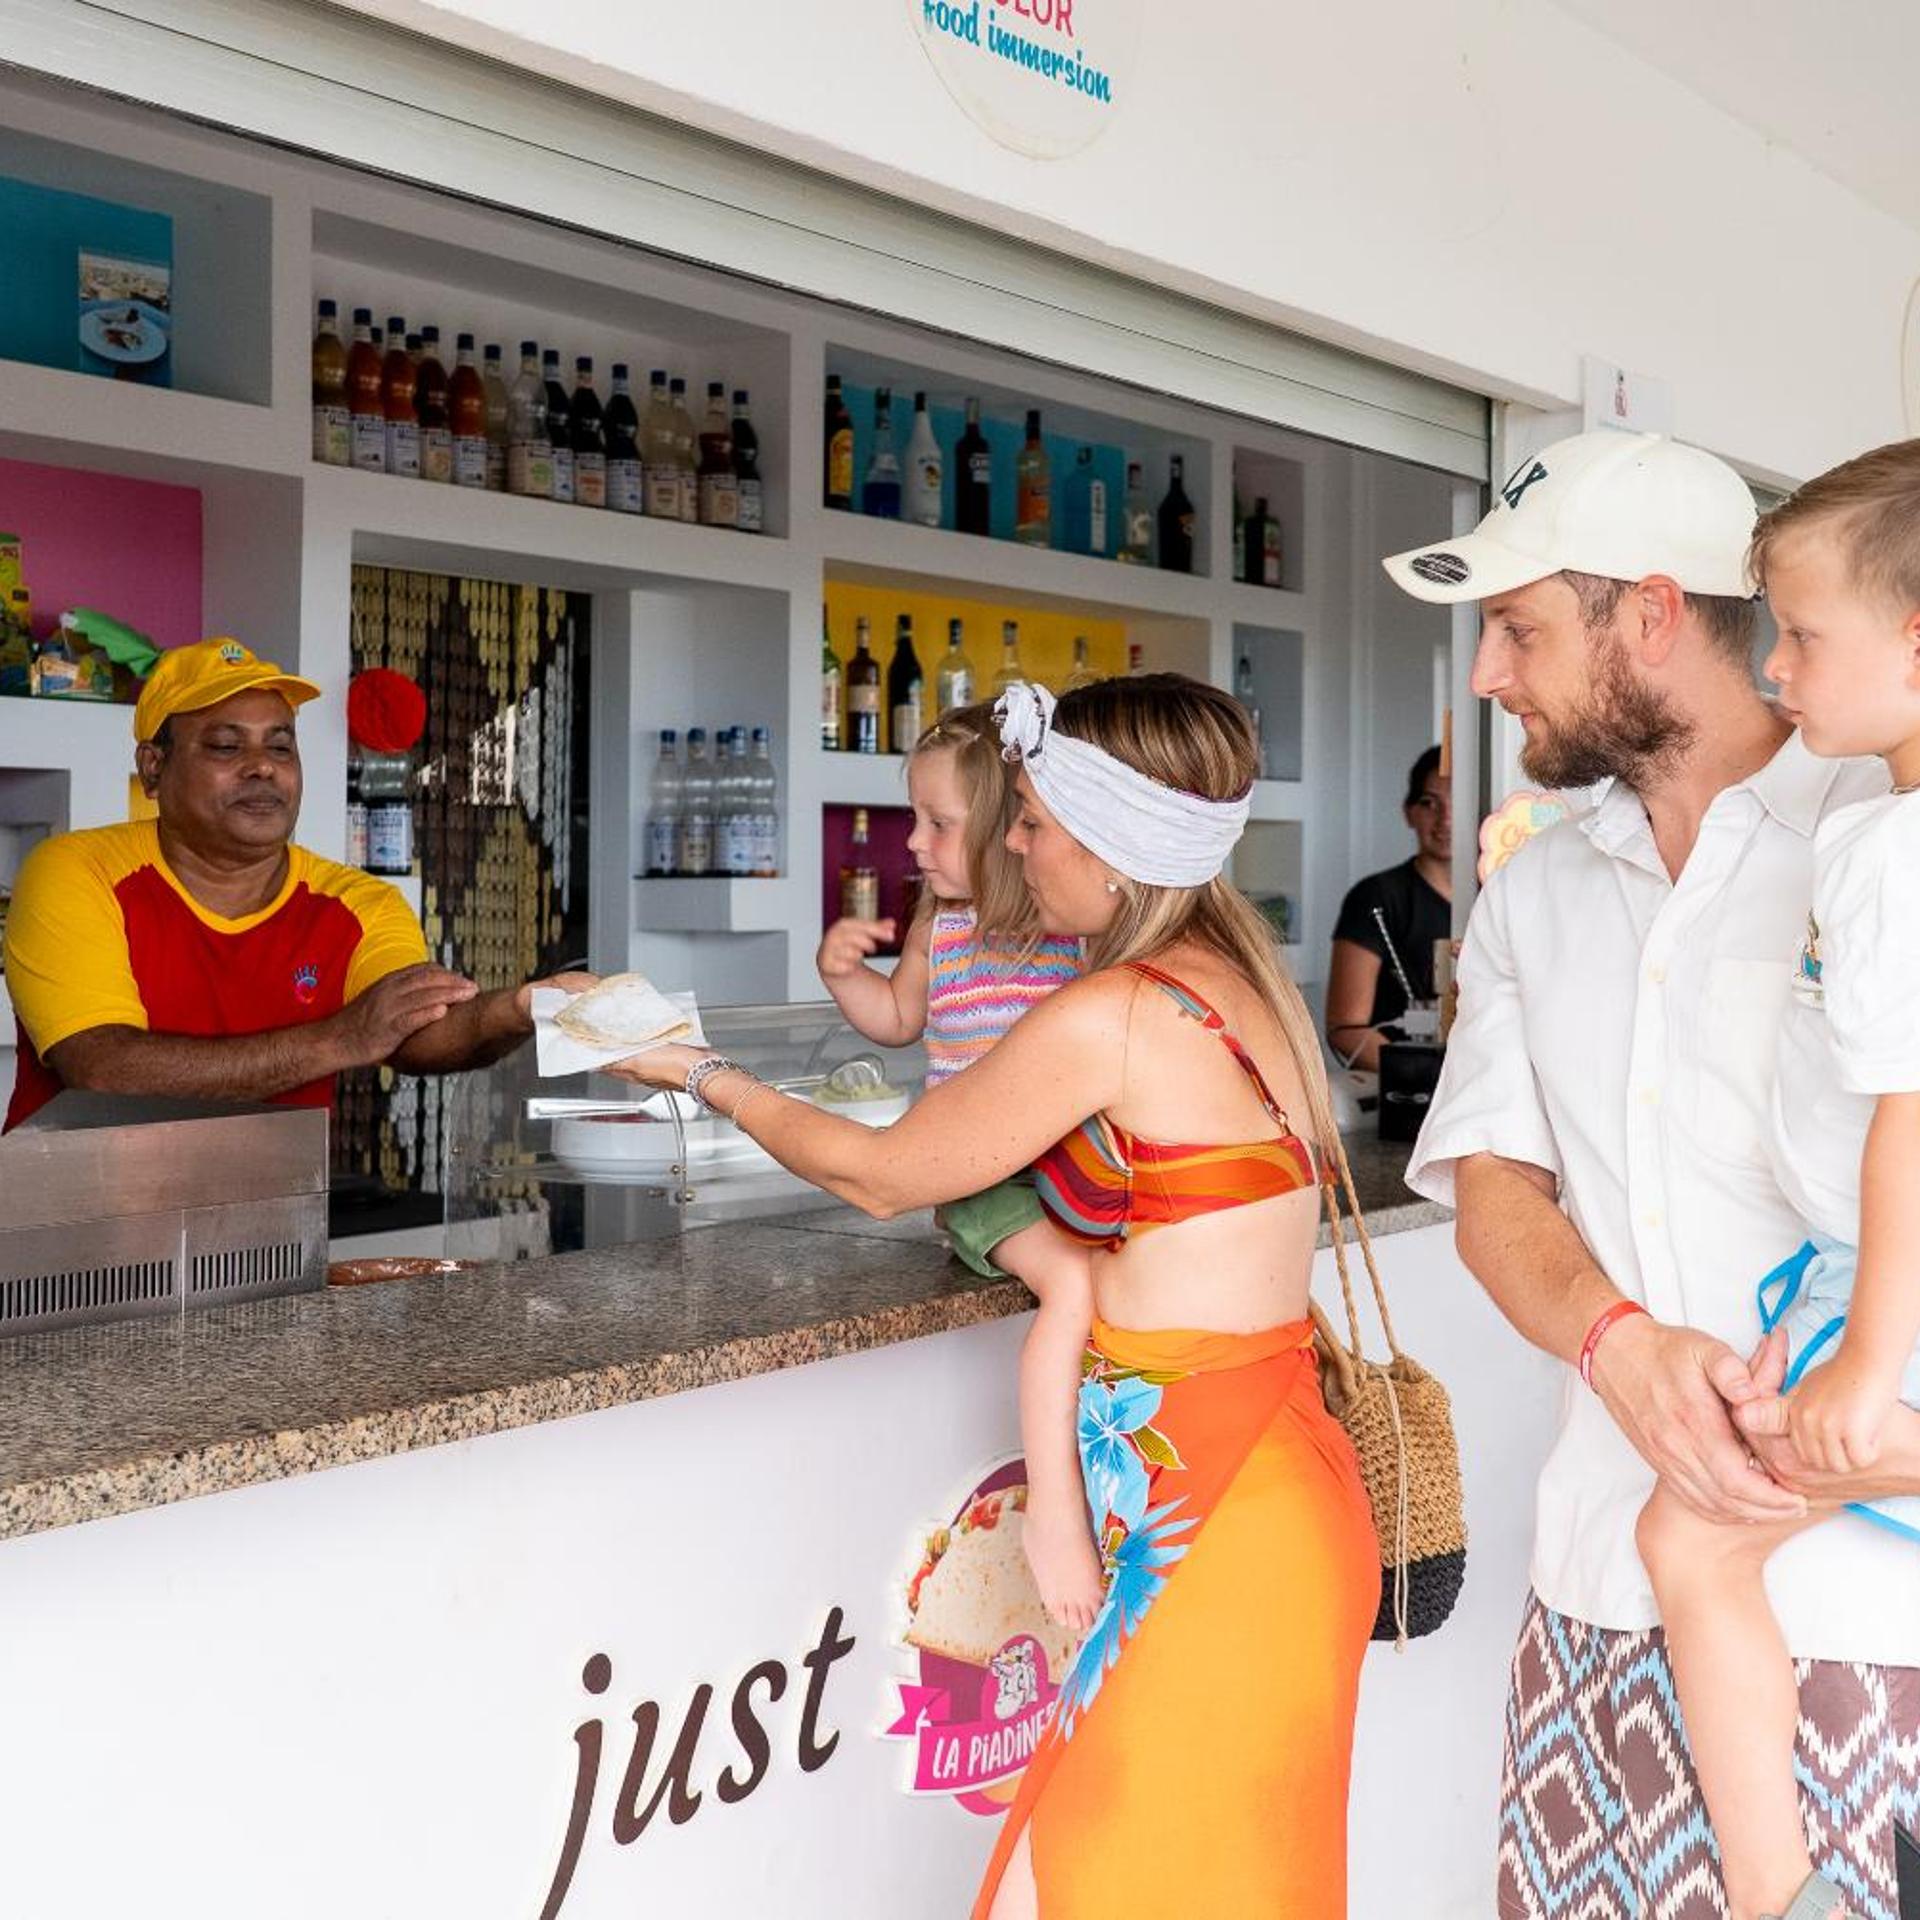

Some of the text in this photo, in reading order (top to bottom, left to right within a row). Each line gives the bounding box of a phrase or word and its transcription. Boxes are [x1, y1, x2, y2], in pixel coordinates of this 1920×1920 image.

[988, 9, 1111, 103] immersion
[539, 1606, 856, 1920] just
[932, 1736, 960, 1779] LA
